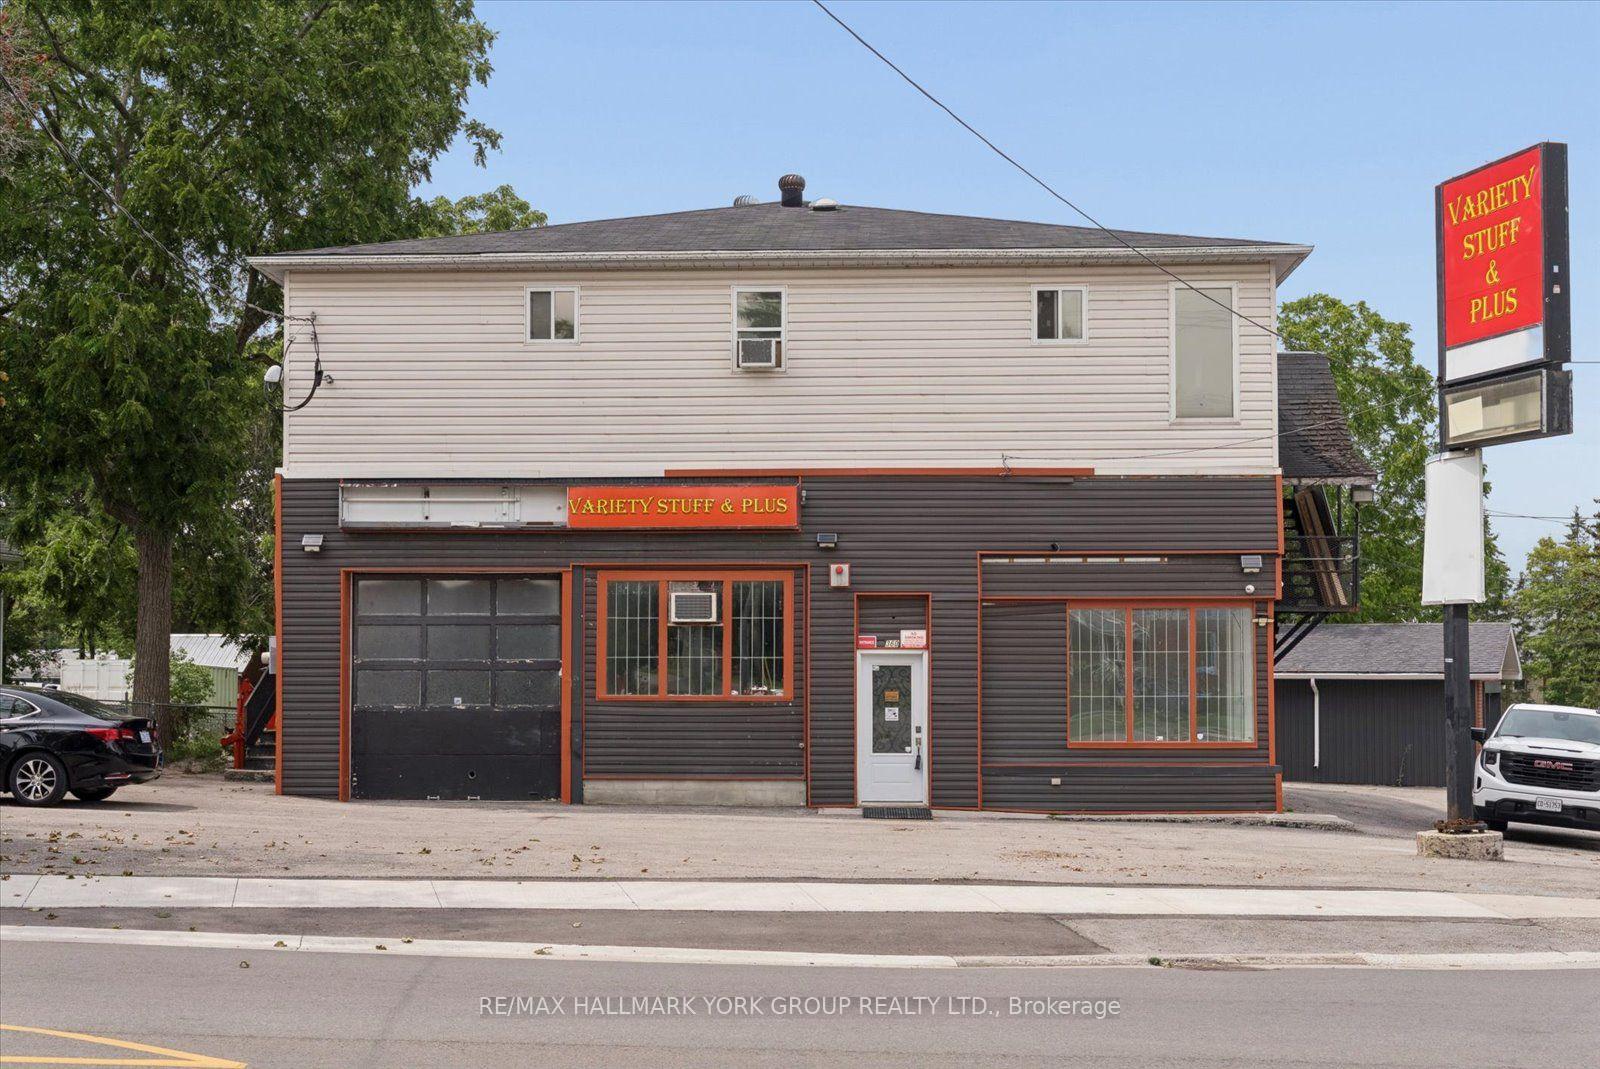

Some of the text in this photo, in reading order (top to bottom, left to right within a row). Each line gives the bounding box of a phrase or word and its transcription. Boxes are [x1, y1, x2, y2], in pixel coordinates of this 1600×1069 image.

[1447, 165, 1536, 226] VARIETY
[1462, 216, 1521, 260] STUFF
[1485, 258, 1500, 285] &
[1469, 287, 1519, 324] PLUS
[568, 496, 788, 514] VARIETY STUFF & PLUS
[1533, 759, 1574, 771] GMC
